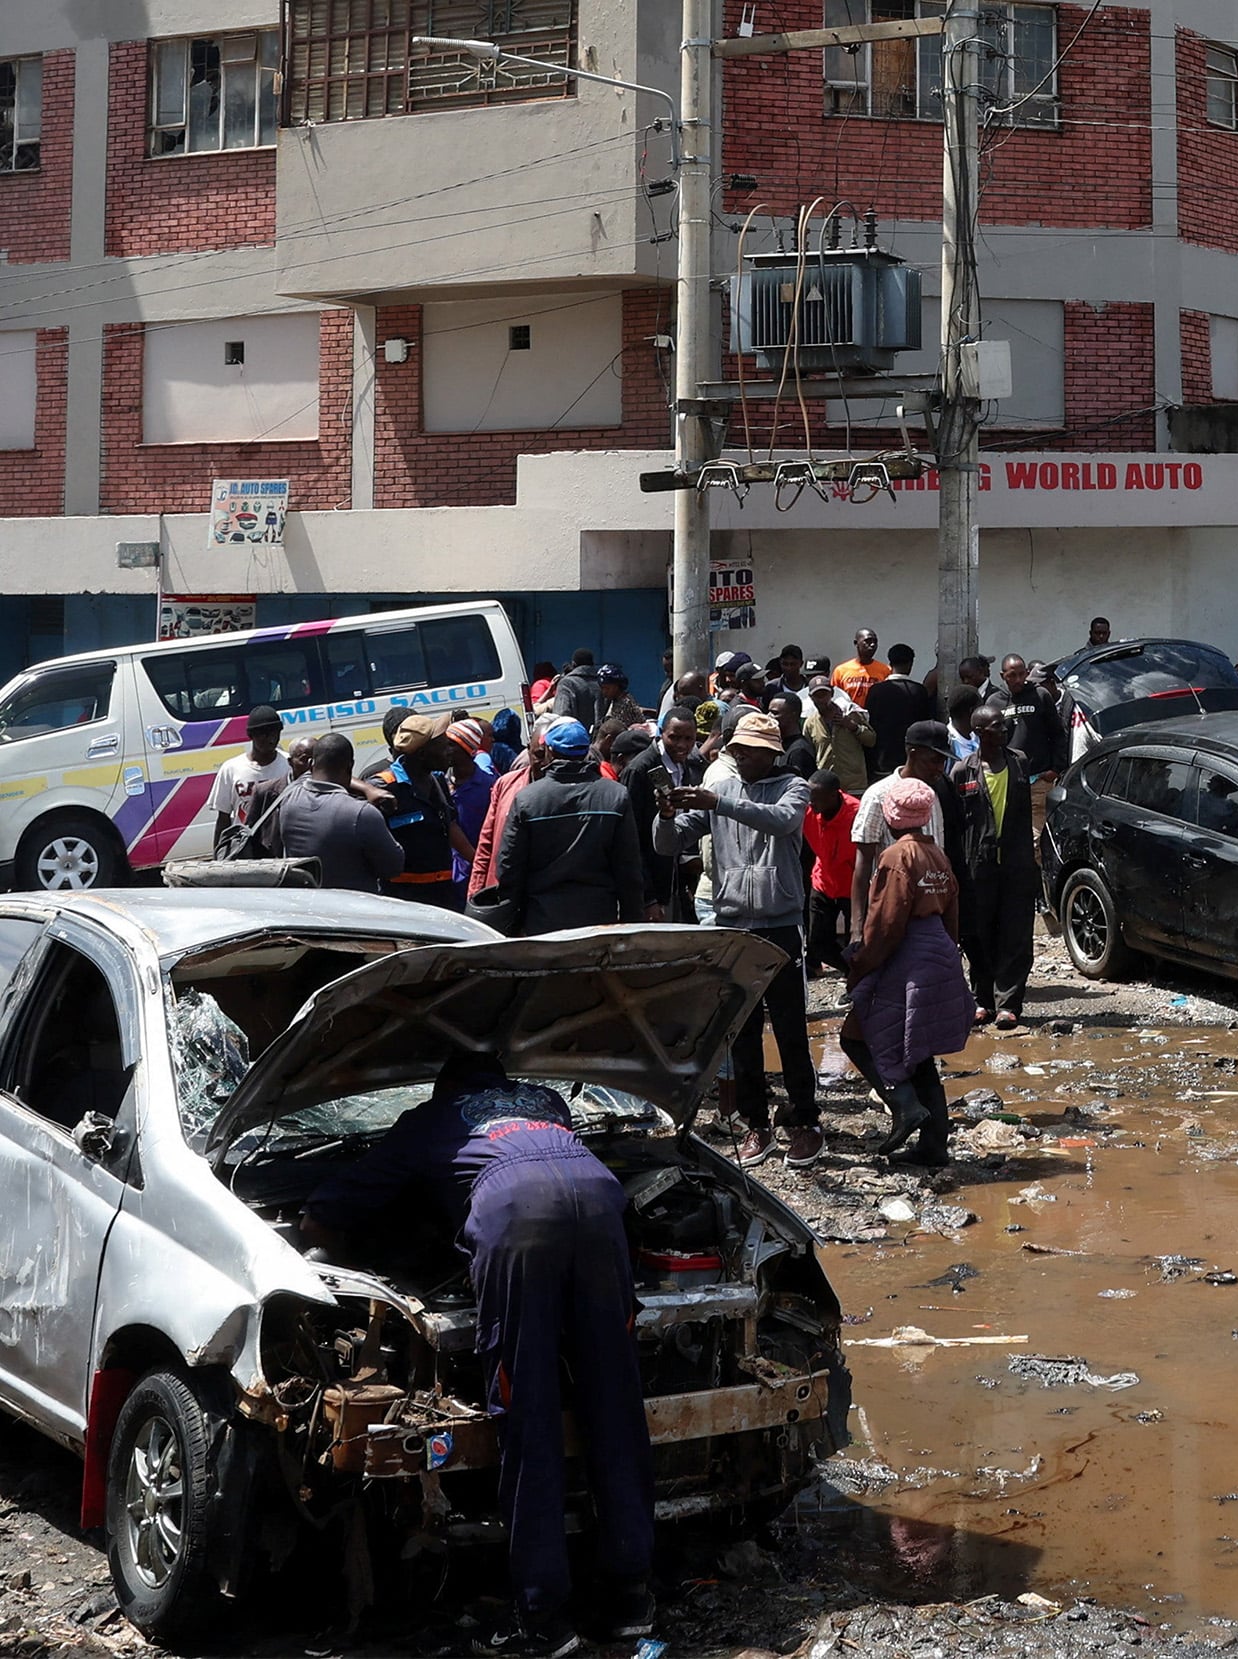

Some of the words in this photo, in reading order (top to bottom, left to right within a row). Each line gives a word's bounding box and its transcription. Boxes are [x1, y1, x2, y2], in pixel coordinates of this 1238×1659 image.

[1005, 462, 1117, 490] WORLD
[1124, 462, 1203, 490] AUTO
[241, 482, 260, 495] AUTO
[709, 585, 754, 603] SPARES
[281, 700, 376, 725] MEISO
[390, 684, 486, 707] SACCO
[1017, 705, 1035, 714] SEED
